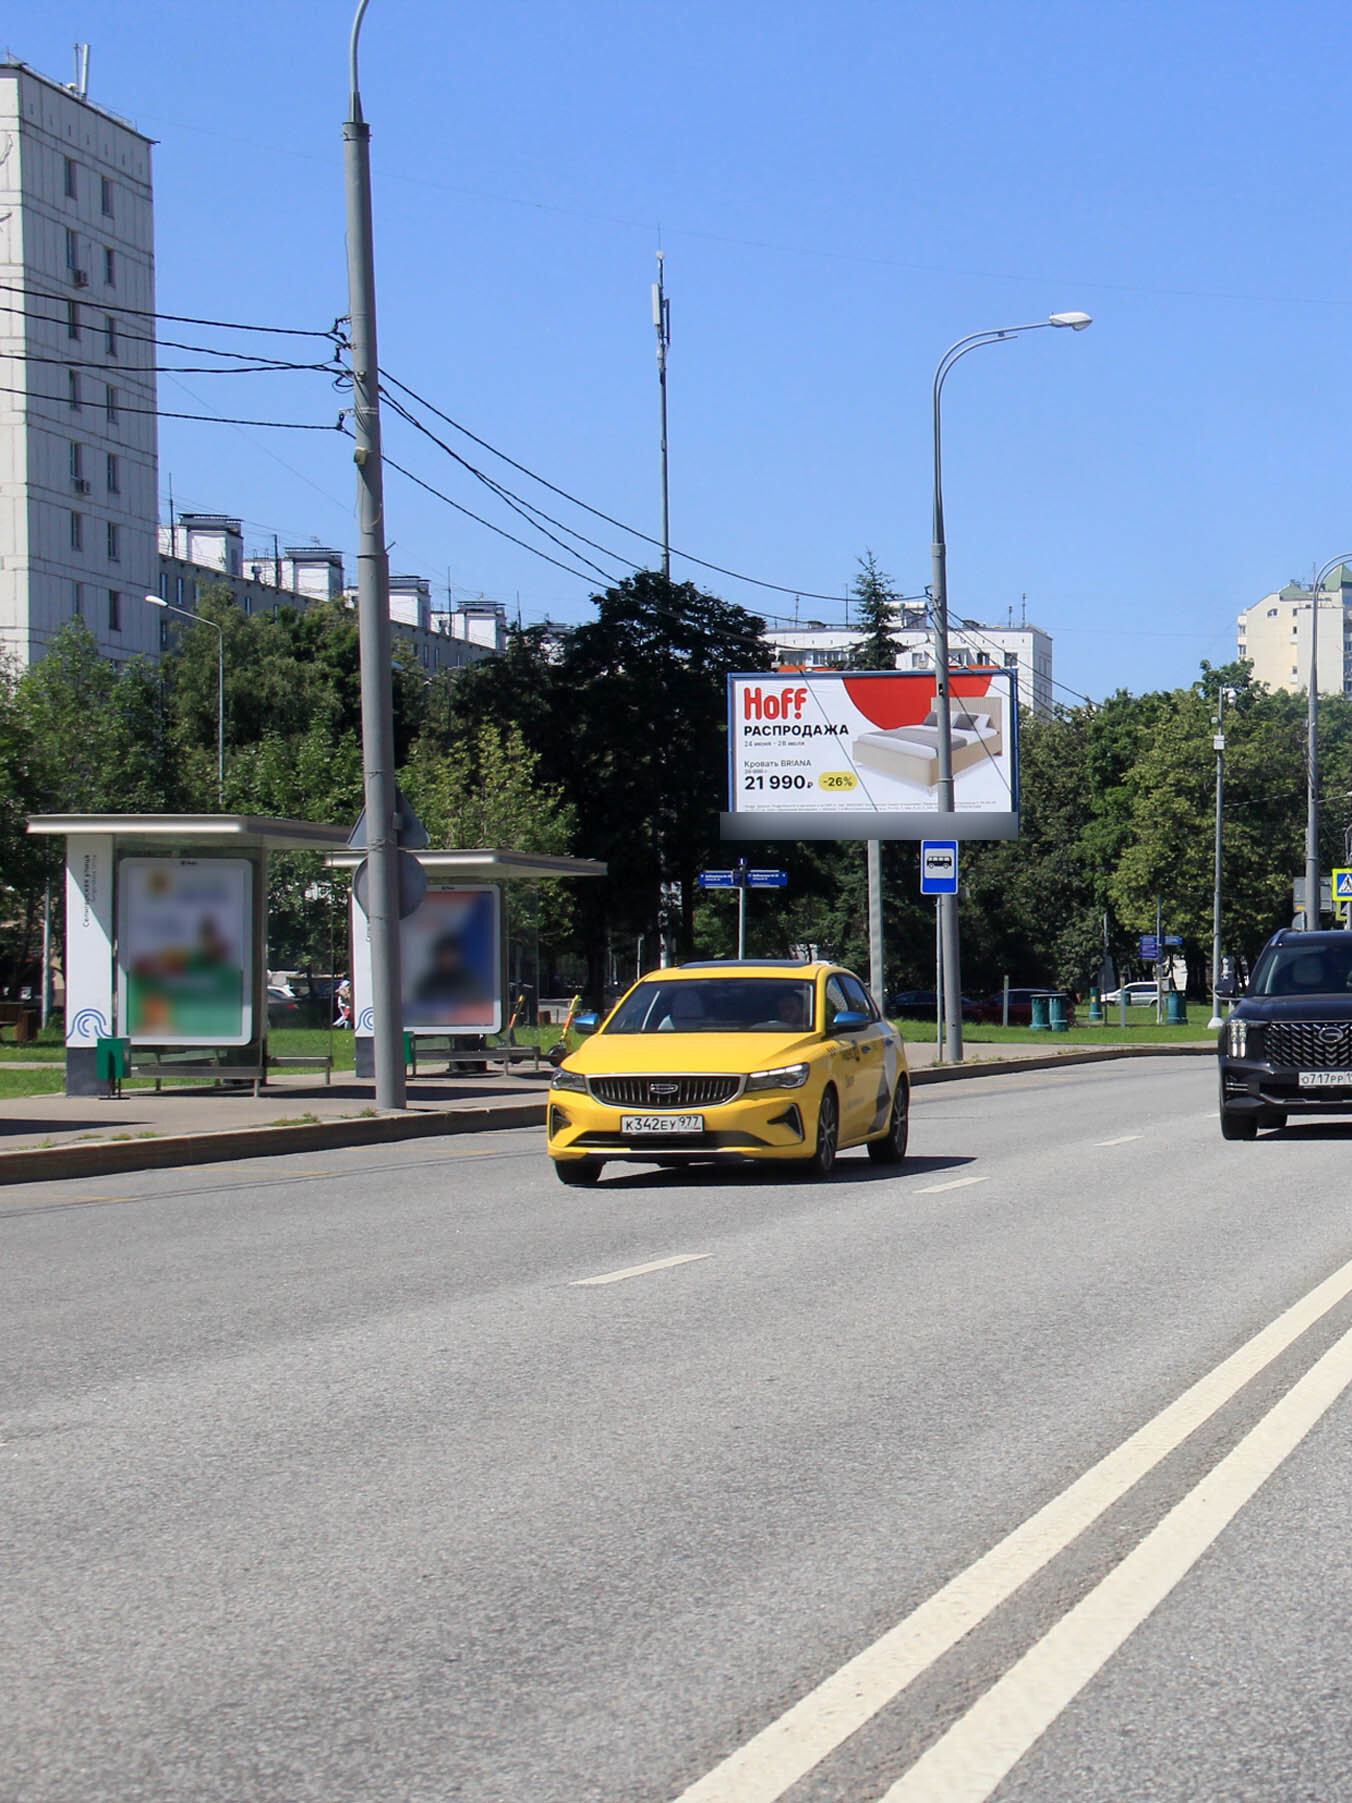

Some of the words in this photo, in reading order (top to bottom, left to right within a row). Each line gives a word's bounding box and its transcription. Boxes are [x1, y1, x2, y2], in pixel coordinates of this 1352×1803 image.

[744, 687, 808, 720] Hoff
[744, 725, 849, 738] РАСПРОДАЖА
[823, 776, 853, 787] -26%
